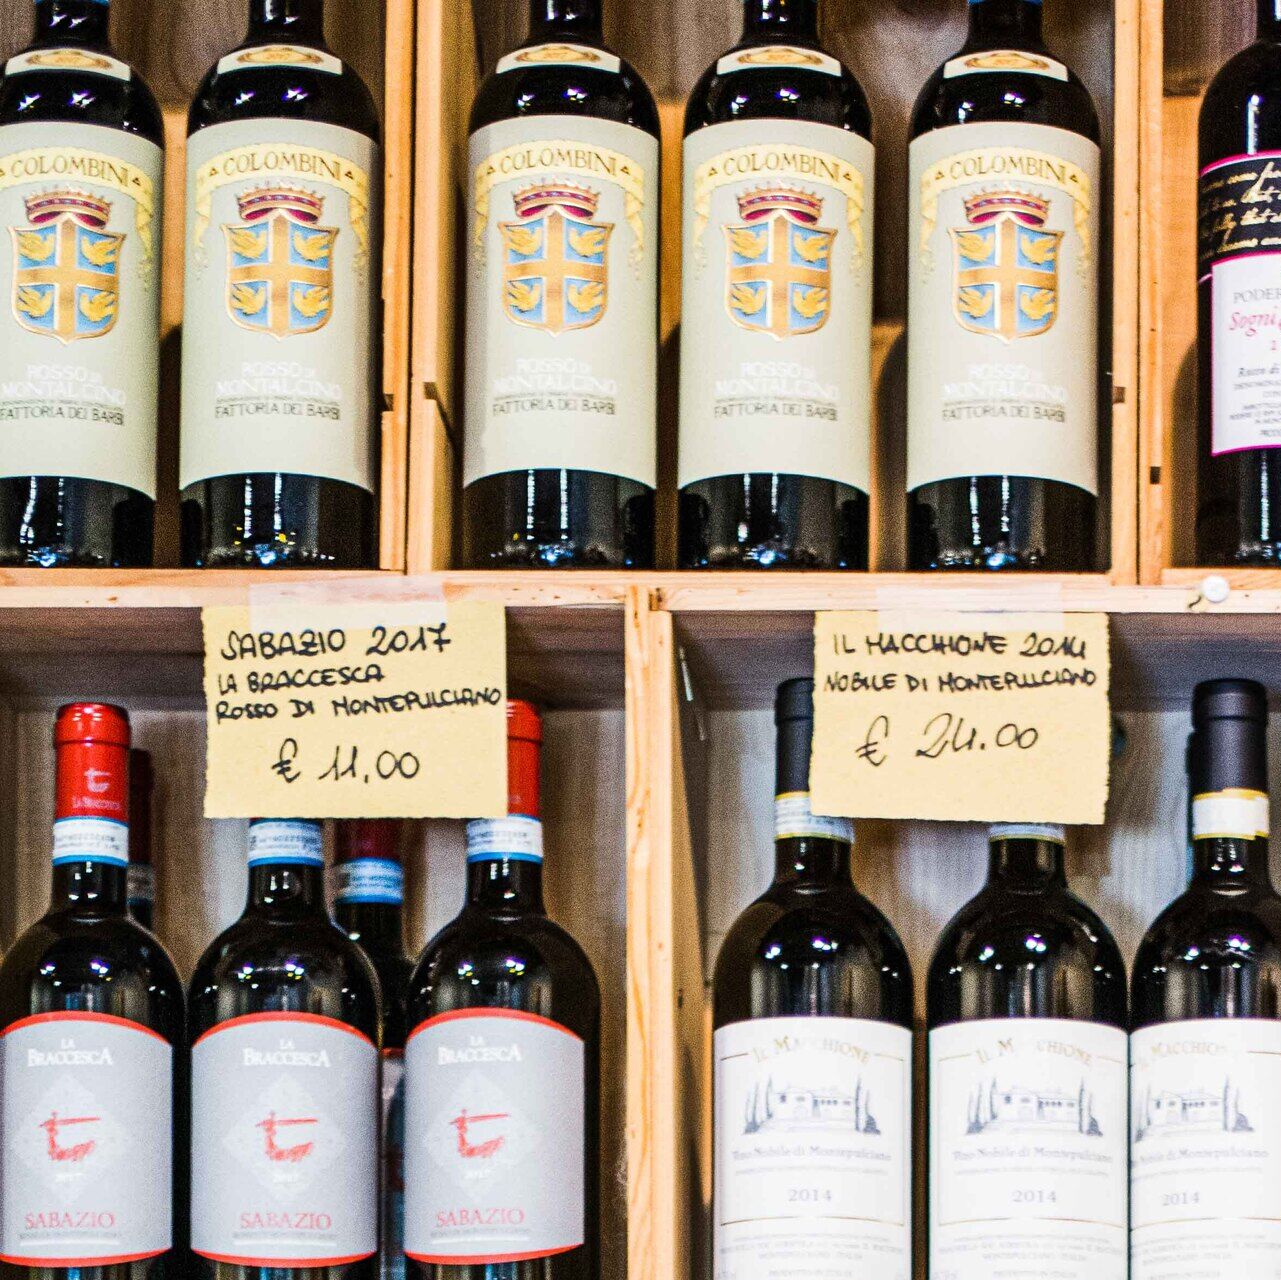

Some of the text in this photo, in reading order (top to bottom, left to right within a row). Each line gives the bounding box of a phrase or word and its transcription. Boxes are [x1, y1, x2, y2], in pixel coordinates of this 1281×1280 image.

[222, 152, 341, 182] COLOMBINI
[1229, 305, 1276, 337] Sogni
[221, 623, 451, 661] SABAZIO 2017
[832, 633, 856, 655] IL
[1018, 632, 1086, 660] 2014
[218, 663, 385, 695] LA BRACCESCA
[216, 700, 278, 725] ROSSO
[291, 699, 315, 719] DI
[788, 1188, 833, 1204] 2014
[24, 1209, 116, 1230] SABAZIO
